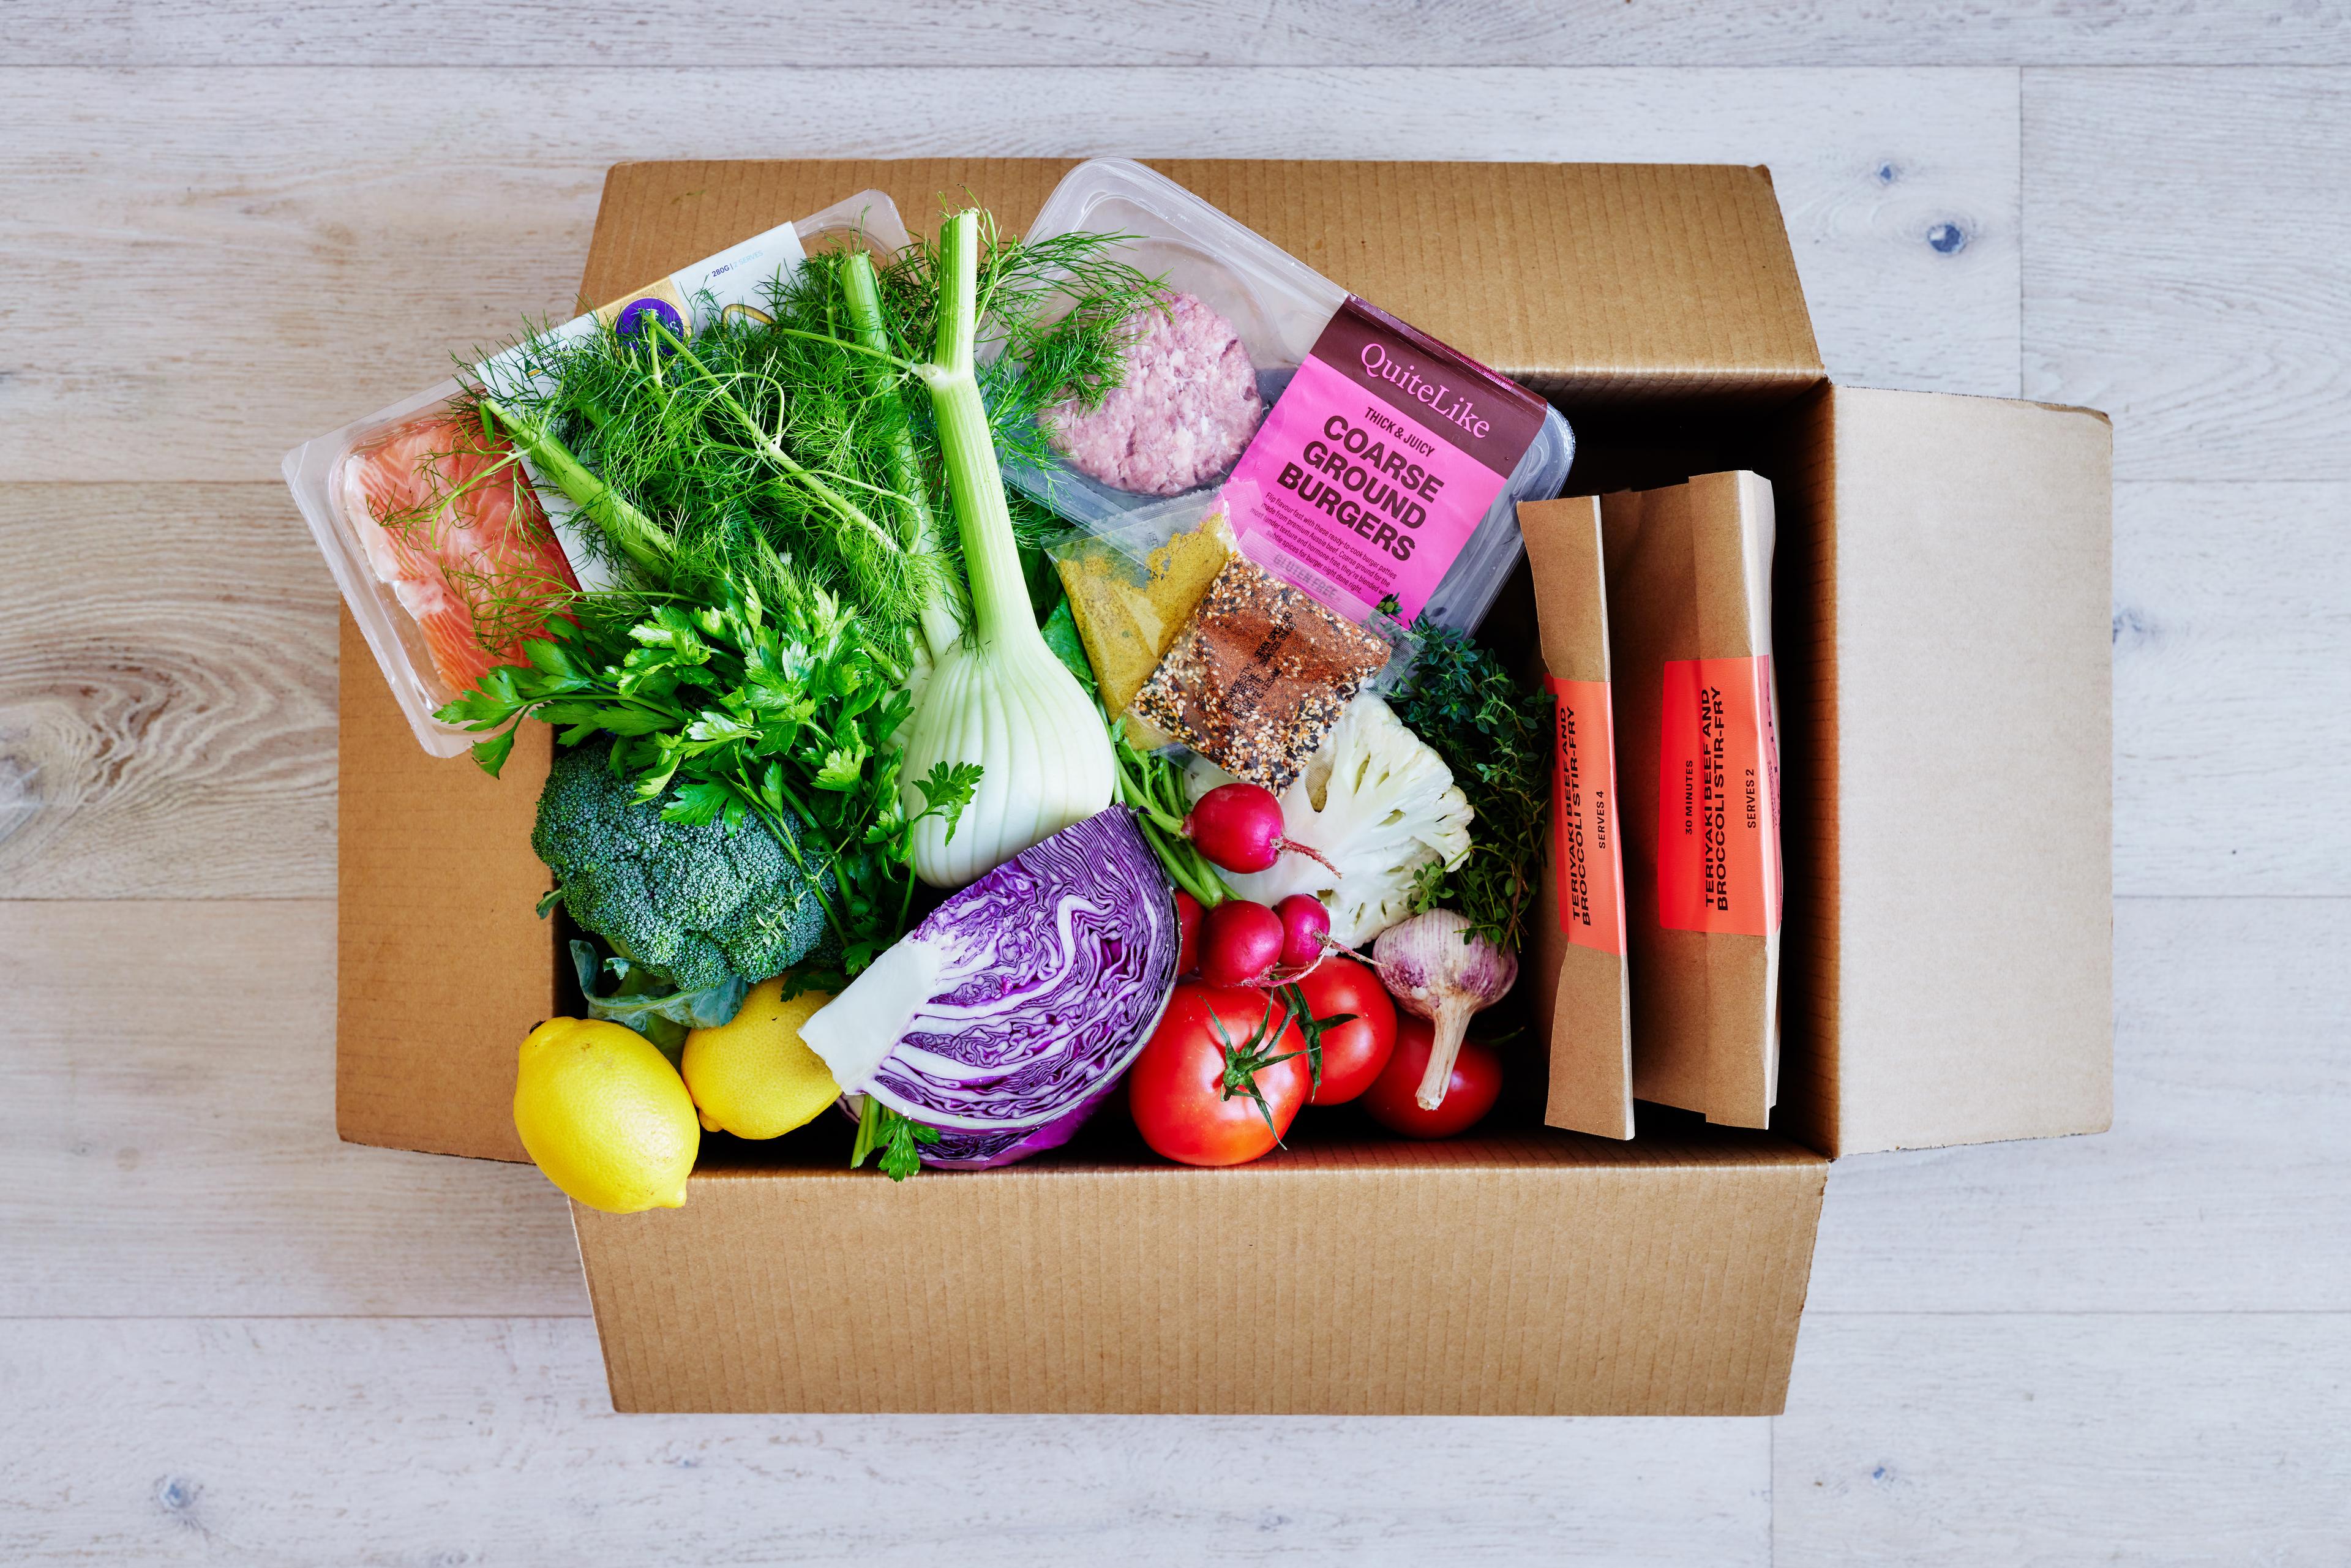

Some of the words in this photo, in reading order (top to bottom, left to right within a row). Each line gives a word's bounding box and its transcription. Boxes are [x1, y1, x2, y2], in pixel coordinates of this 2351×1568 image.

[711, 264, 730, 277] 280G
[737, 249, 764, 265] SERVES
[1362, 343, 1489, 438] QuiteLike
[1500, 381, 1512, 391] HOW
[1324, 416, 1444, 503] COARSE
[1364, 407, 1396, 433] THICK
[1393, 426, 1404, 440] &
[1403, 432, 1435, 458] JUICY
[1277, 462, 1415, 561] BURGERS
[1303, 441, 1426, 528] GROUND
[1249, 507, 1264, 520] most
[1262, 515, 1281, 530] tender
[1278, 525, 1299, 541] texture
[1295, 536, 1308, 547] and
[1305, 542, 1343, 569] hormone-free,
[1340, 564, 1360, 580] they're
[1357, 574, 1379, 592] blended
[1261, 501, 1276, 514] made
[1275, 511, 1288, 522] from
[1286, 519, 1310, 536] premium
[1309, 531, 1327, 546] Aussie
[1325, 542, 1340, 555] beef.
[1338, 550, 1357, 566] Coarse
[1354, 562, 1375, 577] ground
[1373, 572, 1382, 582] for
[1380, 577, 1391, 587] the
[1265, 492, 1277, 503] Flip
[1275, 498, 1294, 514] flavour
[1292, 509, 1304, 520] fast
[1303, 517, 1315, 528] with
[1314, 523, 1330, 536] these
[1327, 533, 1363, 558] ready-to-cook
[1362, 553, 1380, 568] burger
[1378, 565, 1397, 579] patties
[1265, 529, 1283, 543] subtle
[1281, 539, 1299, 554] spices
[1298, 549, 1307, 558] for
[1305, 553, 1324, 569] burger
[1321, 565, 1337, 578] night
[1335, 573, 1349, 585] done
[1348, 582, 1363, 594] right.
[1272, 553, 1313, 584] GLUTEN
[1310, 577, 1338, 600] FREE
[1279, 610, 1293, 625] 10G
[1237, 670, 1259, 697] BEFORE
[1701, 689, 1711, 738] AND
[1567, 705, 1580, 807] STIR-FRY
[1703, 743, 1712, 800] BEEF
[1711, 686, 1723, 788] STIR-FRY
[1563, 759, 1573, 817] BEEF
[1597, 800, 1605, 849] SERVES
[1746, 779, 1756, 828] SERVES
[1685, 820, 1692, 835] 30
[1704, 806, 1714, 907] TERIYAKI
[1714, 794, 1728, 910] BROCCOLI
[1567, 821, 1579, 920] TERIYAKI
[1573, 811, 1591, 926] BROCCOLI
